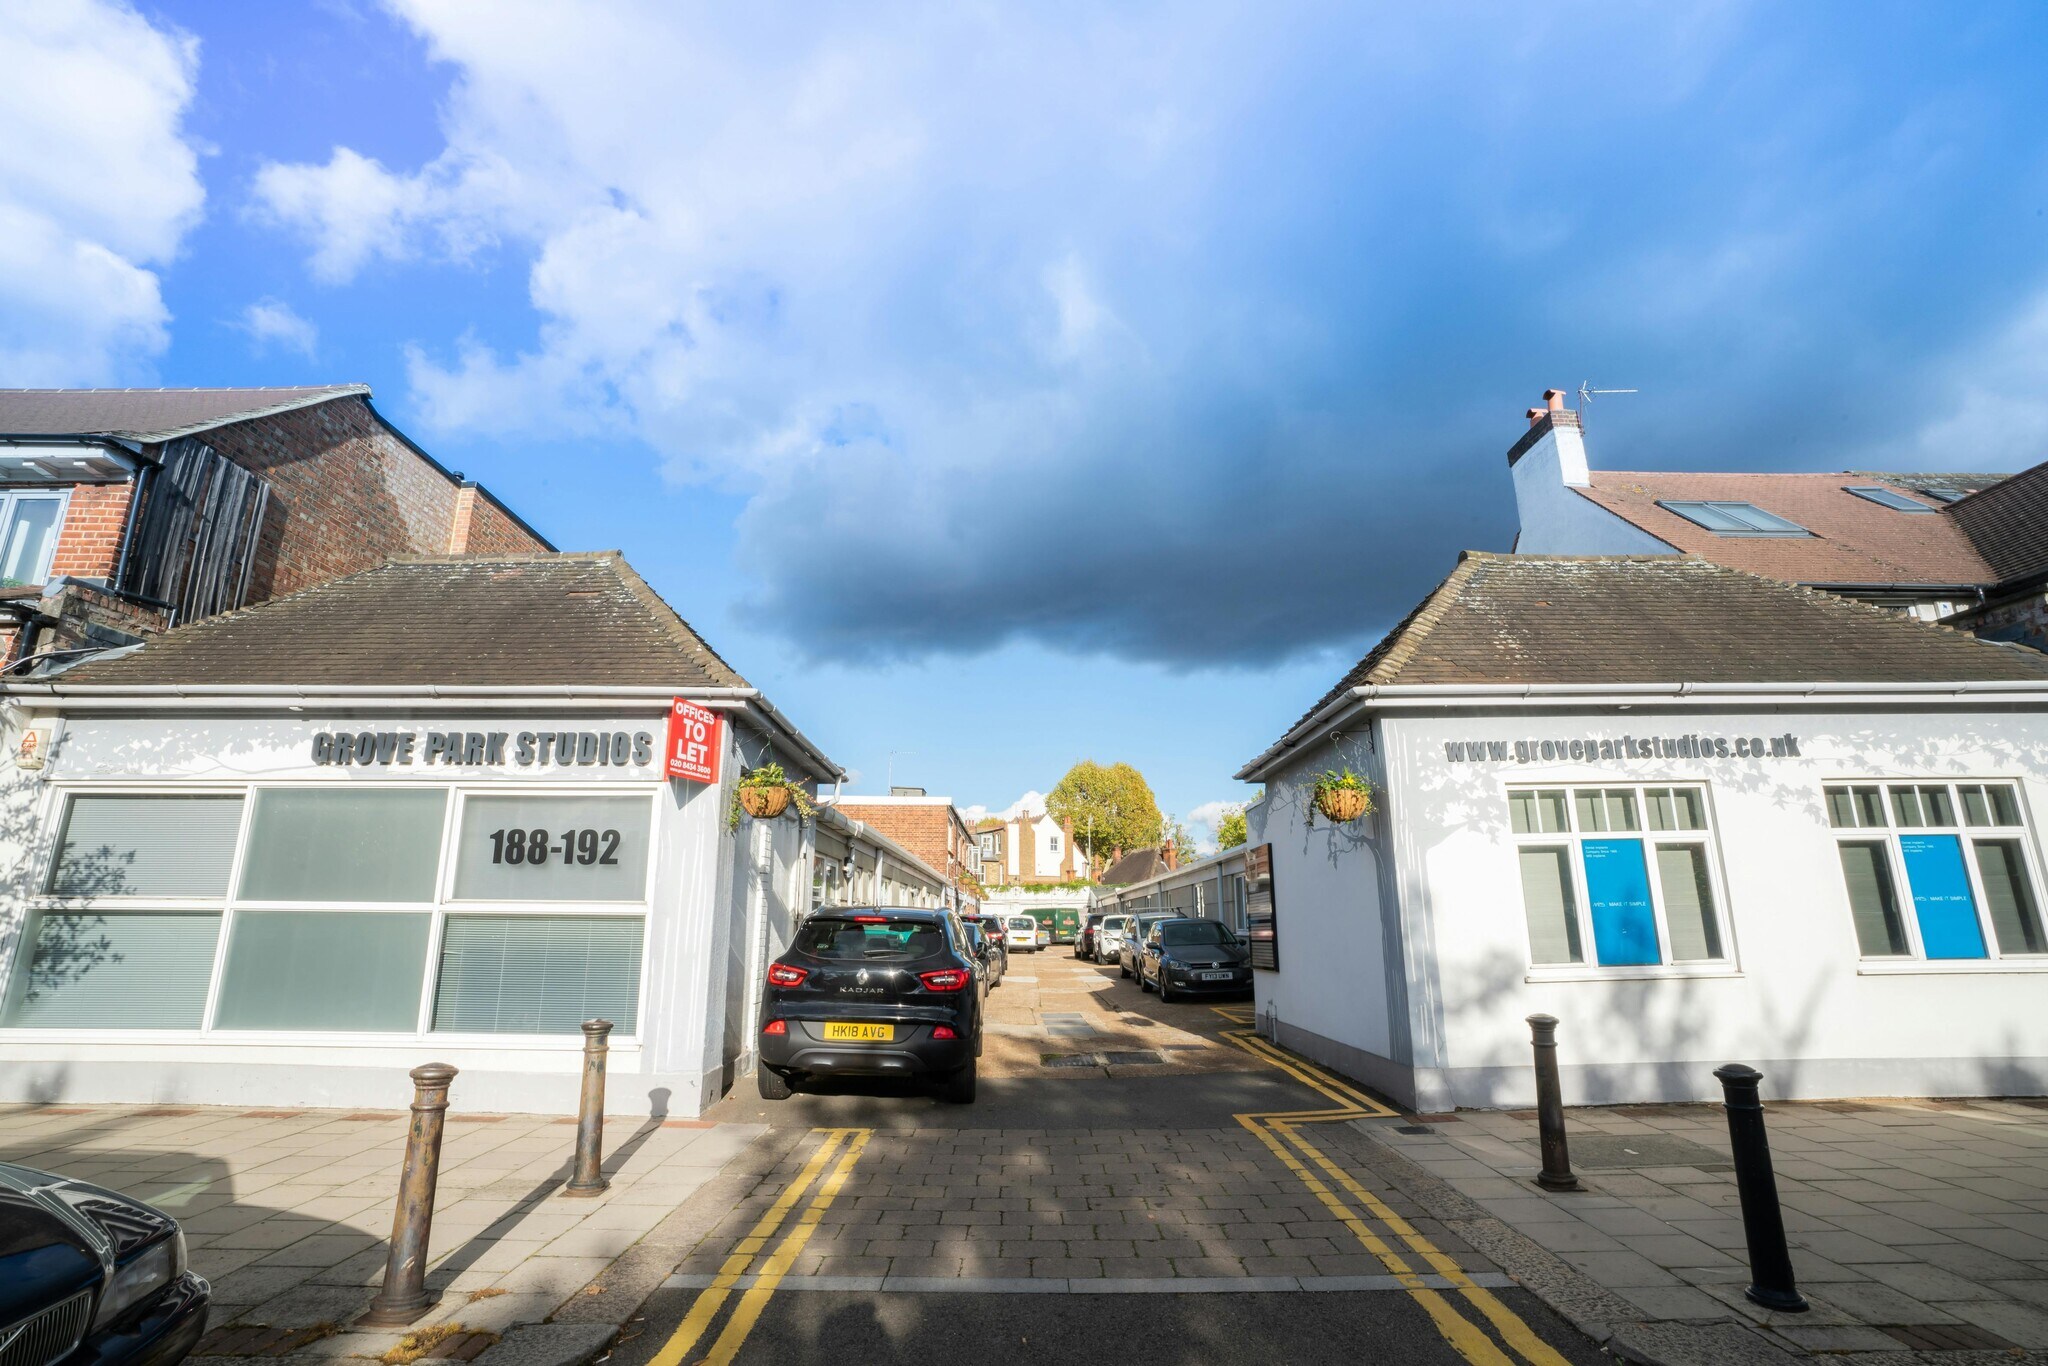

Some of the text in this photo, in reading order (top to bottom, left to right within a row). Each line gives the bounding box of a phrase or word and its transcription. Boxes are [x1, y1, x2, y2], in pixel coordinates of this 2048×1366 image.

[675, 702, 715, 725] OFFICES
[683, 718, 706, 742] TO
[311, 731, 653, 767] GROVE PARK STUDIOS
[677, 739, 708, 764] LET
[1444, 733, 1802, 764] www.groveparkstudios.co.uk
[670, 758, 682, 768] 020
[682, 761, 697, 771] 8434
[490, 829, 621, 865] 188-192
[840, 986, 884, 994] KADJAR
[832, 1025, 885, 1038] HK18 AVG
